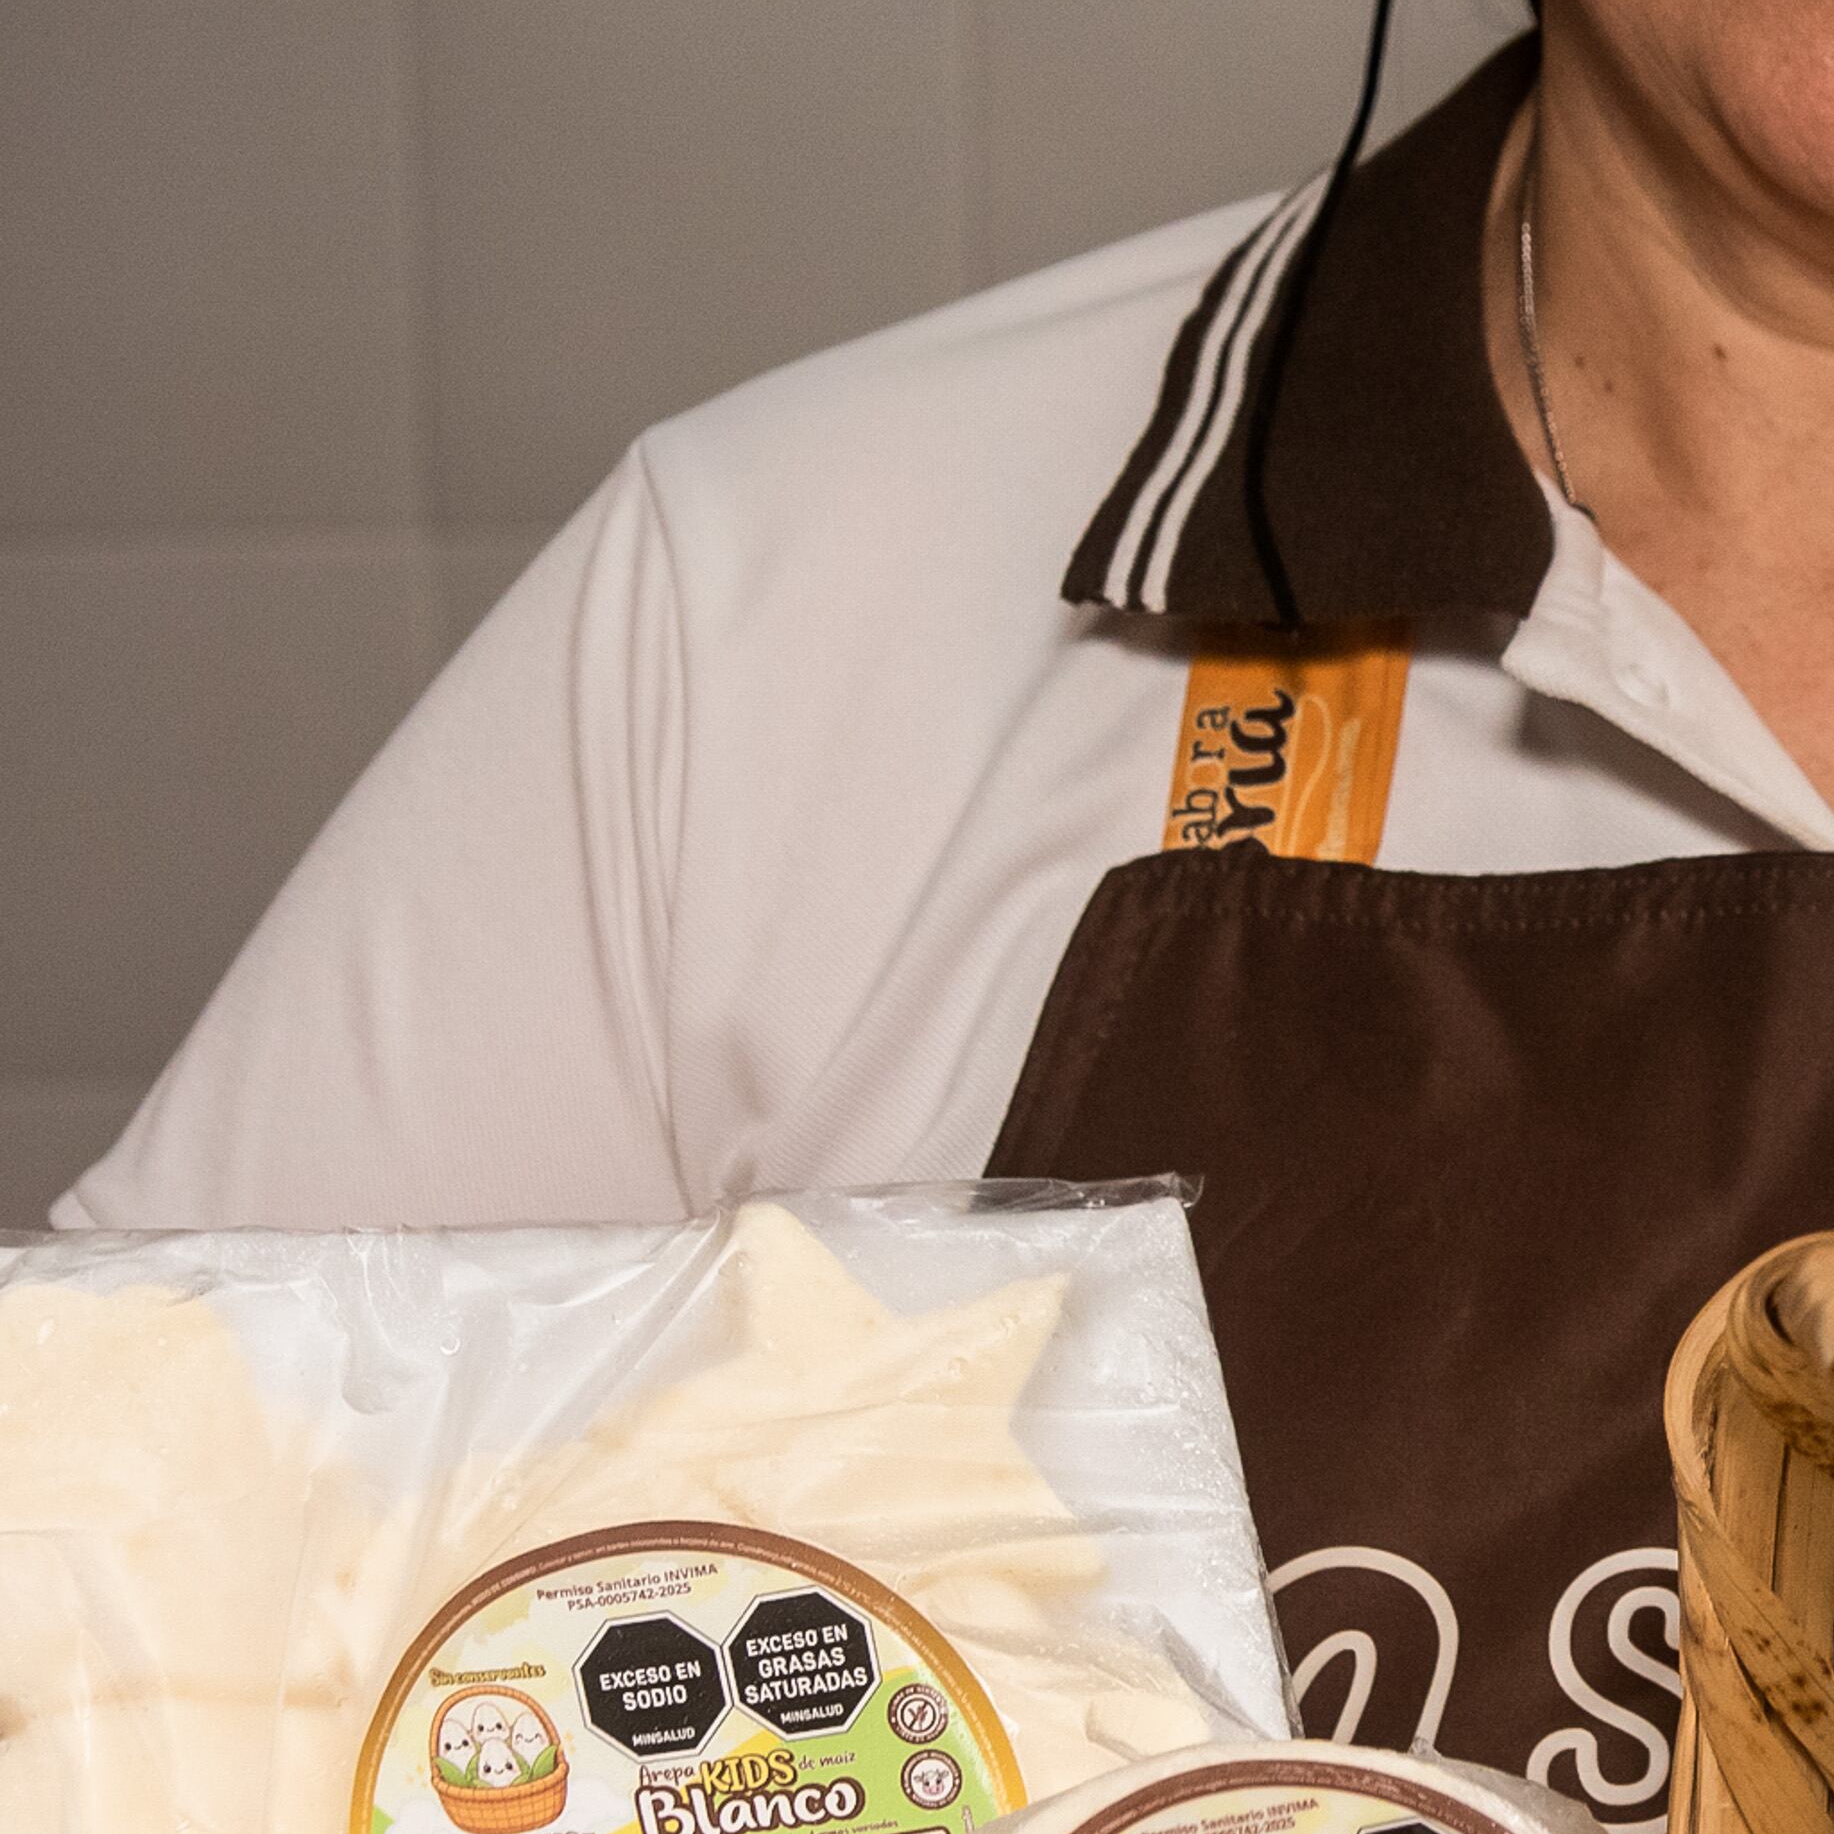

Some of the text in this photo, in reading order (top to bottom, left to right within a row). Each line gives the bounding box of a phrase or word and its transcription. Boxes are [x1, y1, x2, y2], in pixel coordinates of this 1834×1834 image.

[1172, 740, 1225, 849] abor
[537, 1563, 719, 1600] Permiso Sanitario INVIMA
[567, 1582, 692, 1611] PSA-0005742-2025
[746, 1624, 849, 1657] EXCESO EN
[600, 1661, 702, 1692] EXCESO EN
[758, 1647, 846, 1679] GRASAS
[622, 1685, 687, 1712] SODIO
[744, 1667, 868, 1705] SATURADAS
[780, 1703, 845, 1725] MINSALUD
[632, 1726, 696, 1748] MINSALUD
[639, 1764, 695, 1786] Arepa
[699, 1748, 798, 1795] KIDS
[798, 1757, 815, 1771] de
